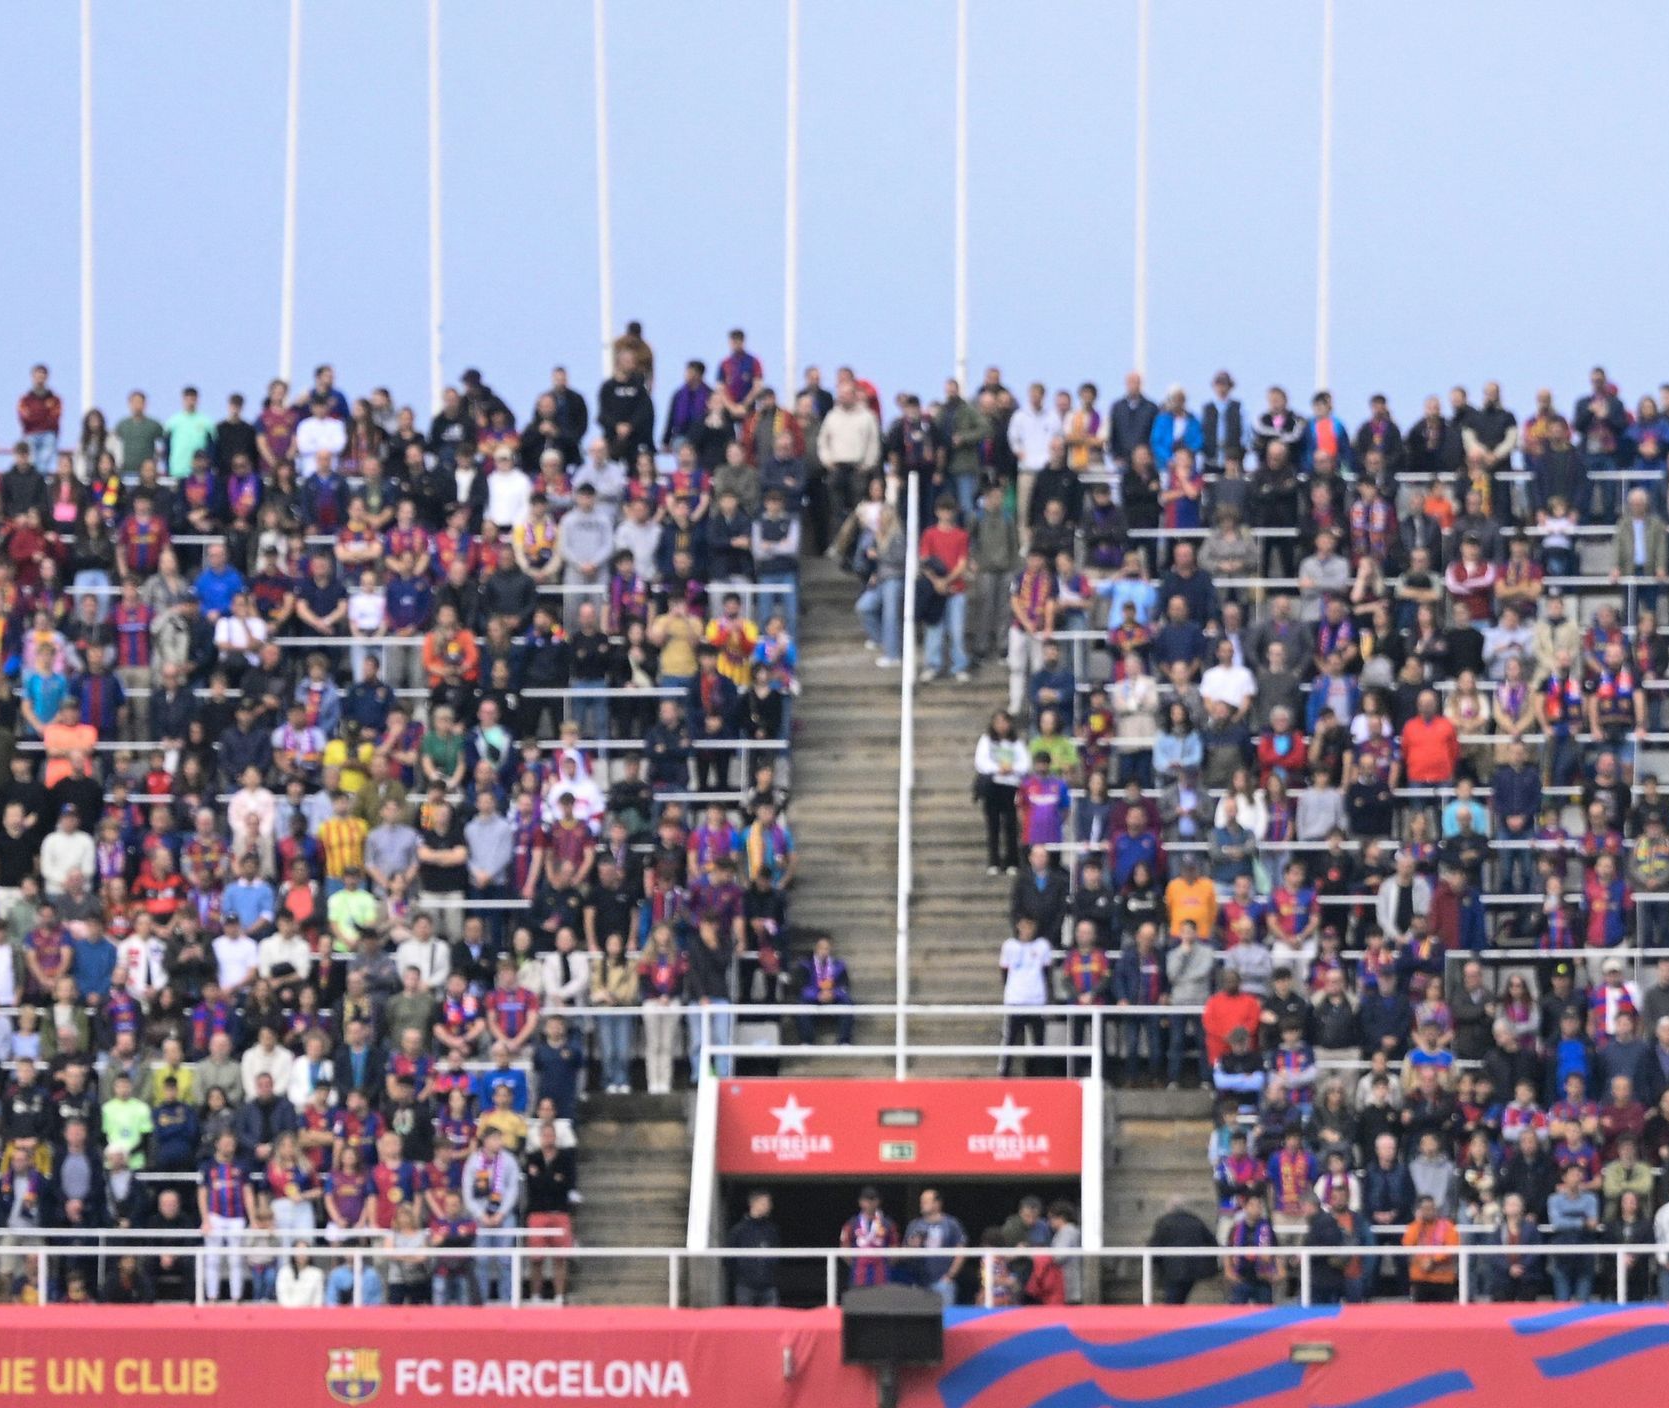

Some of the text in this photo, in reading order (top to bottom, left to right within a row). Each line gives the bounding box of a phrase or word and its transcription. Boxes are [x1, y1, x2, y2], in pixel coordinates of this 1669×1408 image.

[47, 1357, 103, 1393] UN
[115, 1357, 218, 1394] CLUB
[395, 1359, 690, 1397] FC BARCELONA
